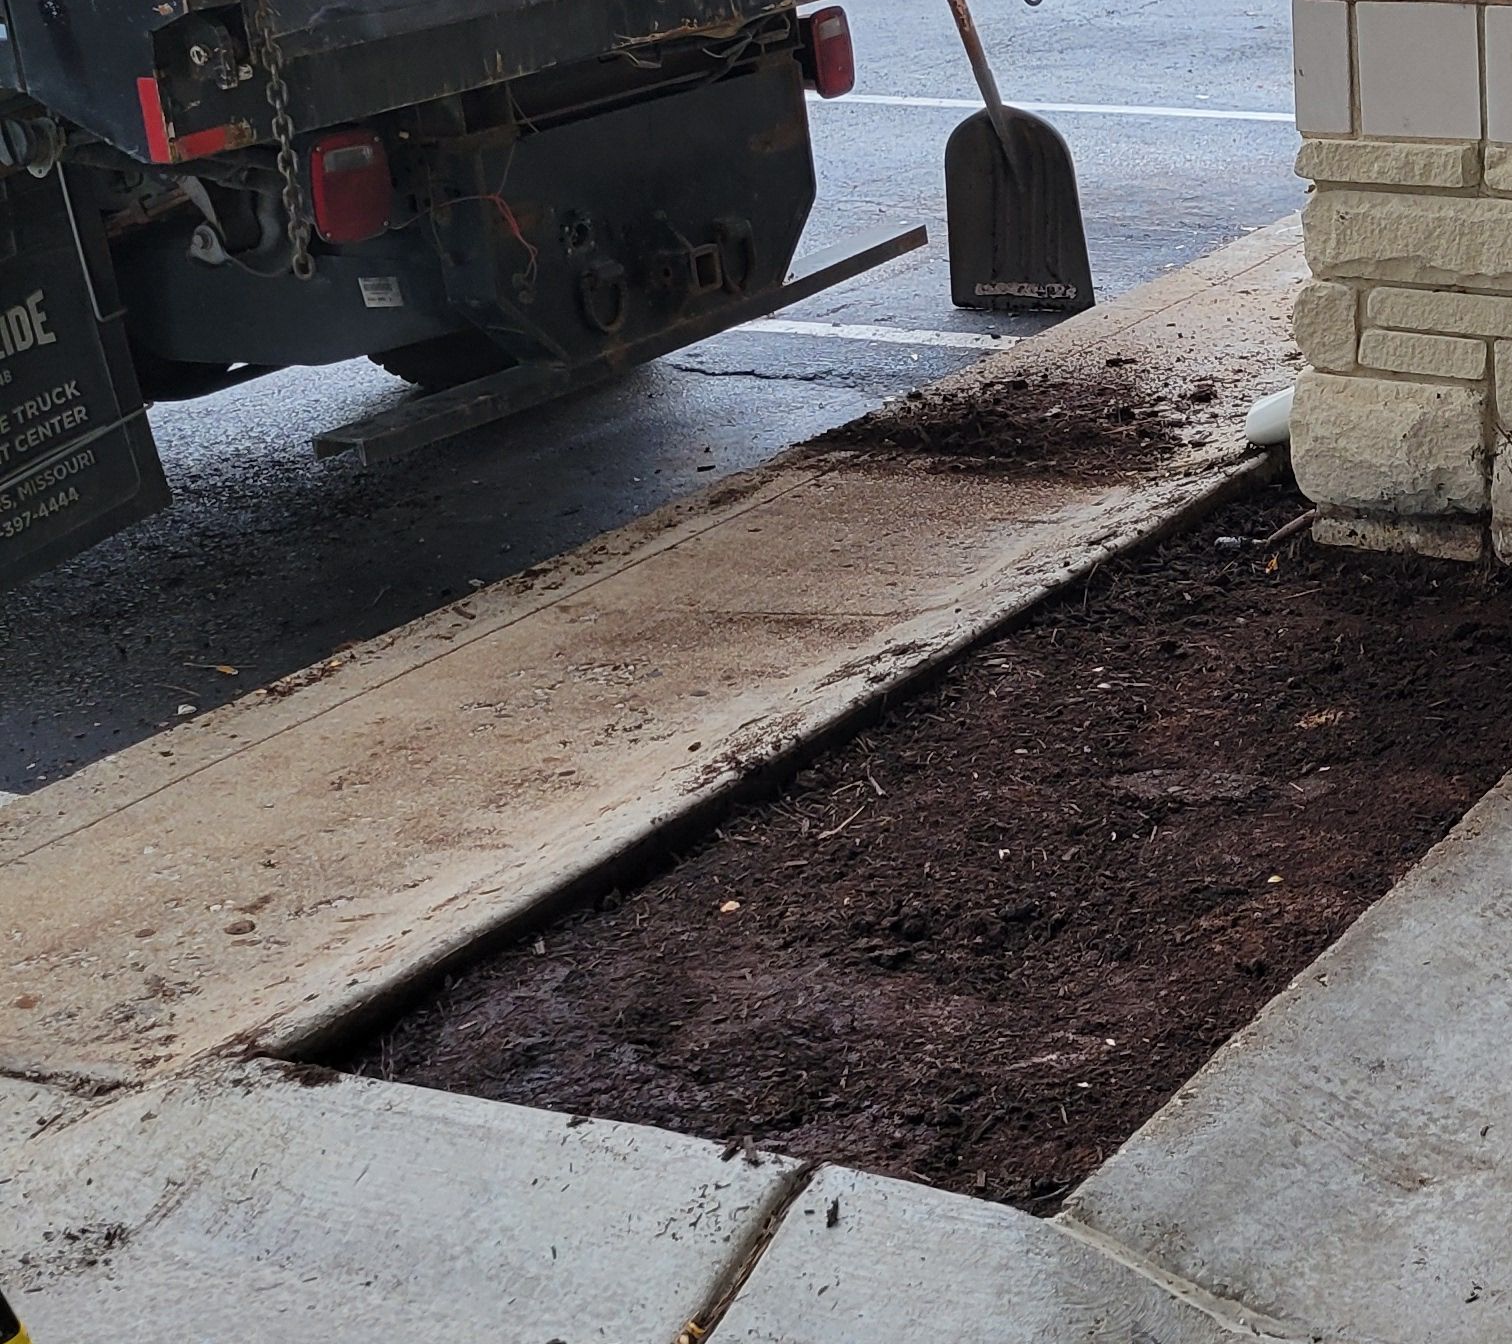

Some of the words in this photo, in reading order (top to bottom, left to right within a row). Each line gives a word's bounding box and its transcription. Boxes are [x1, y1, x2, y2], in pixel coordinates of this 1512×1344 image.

[12, 380, 81, 424] TRUCK
[15, 406, 89, 452] CENTER
[17, 449, 96, 501] MISSOURI
